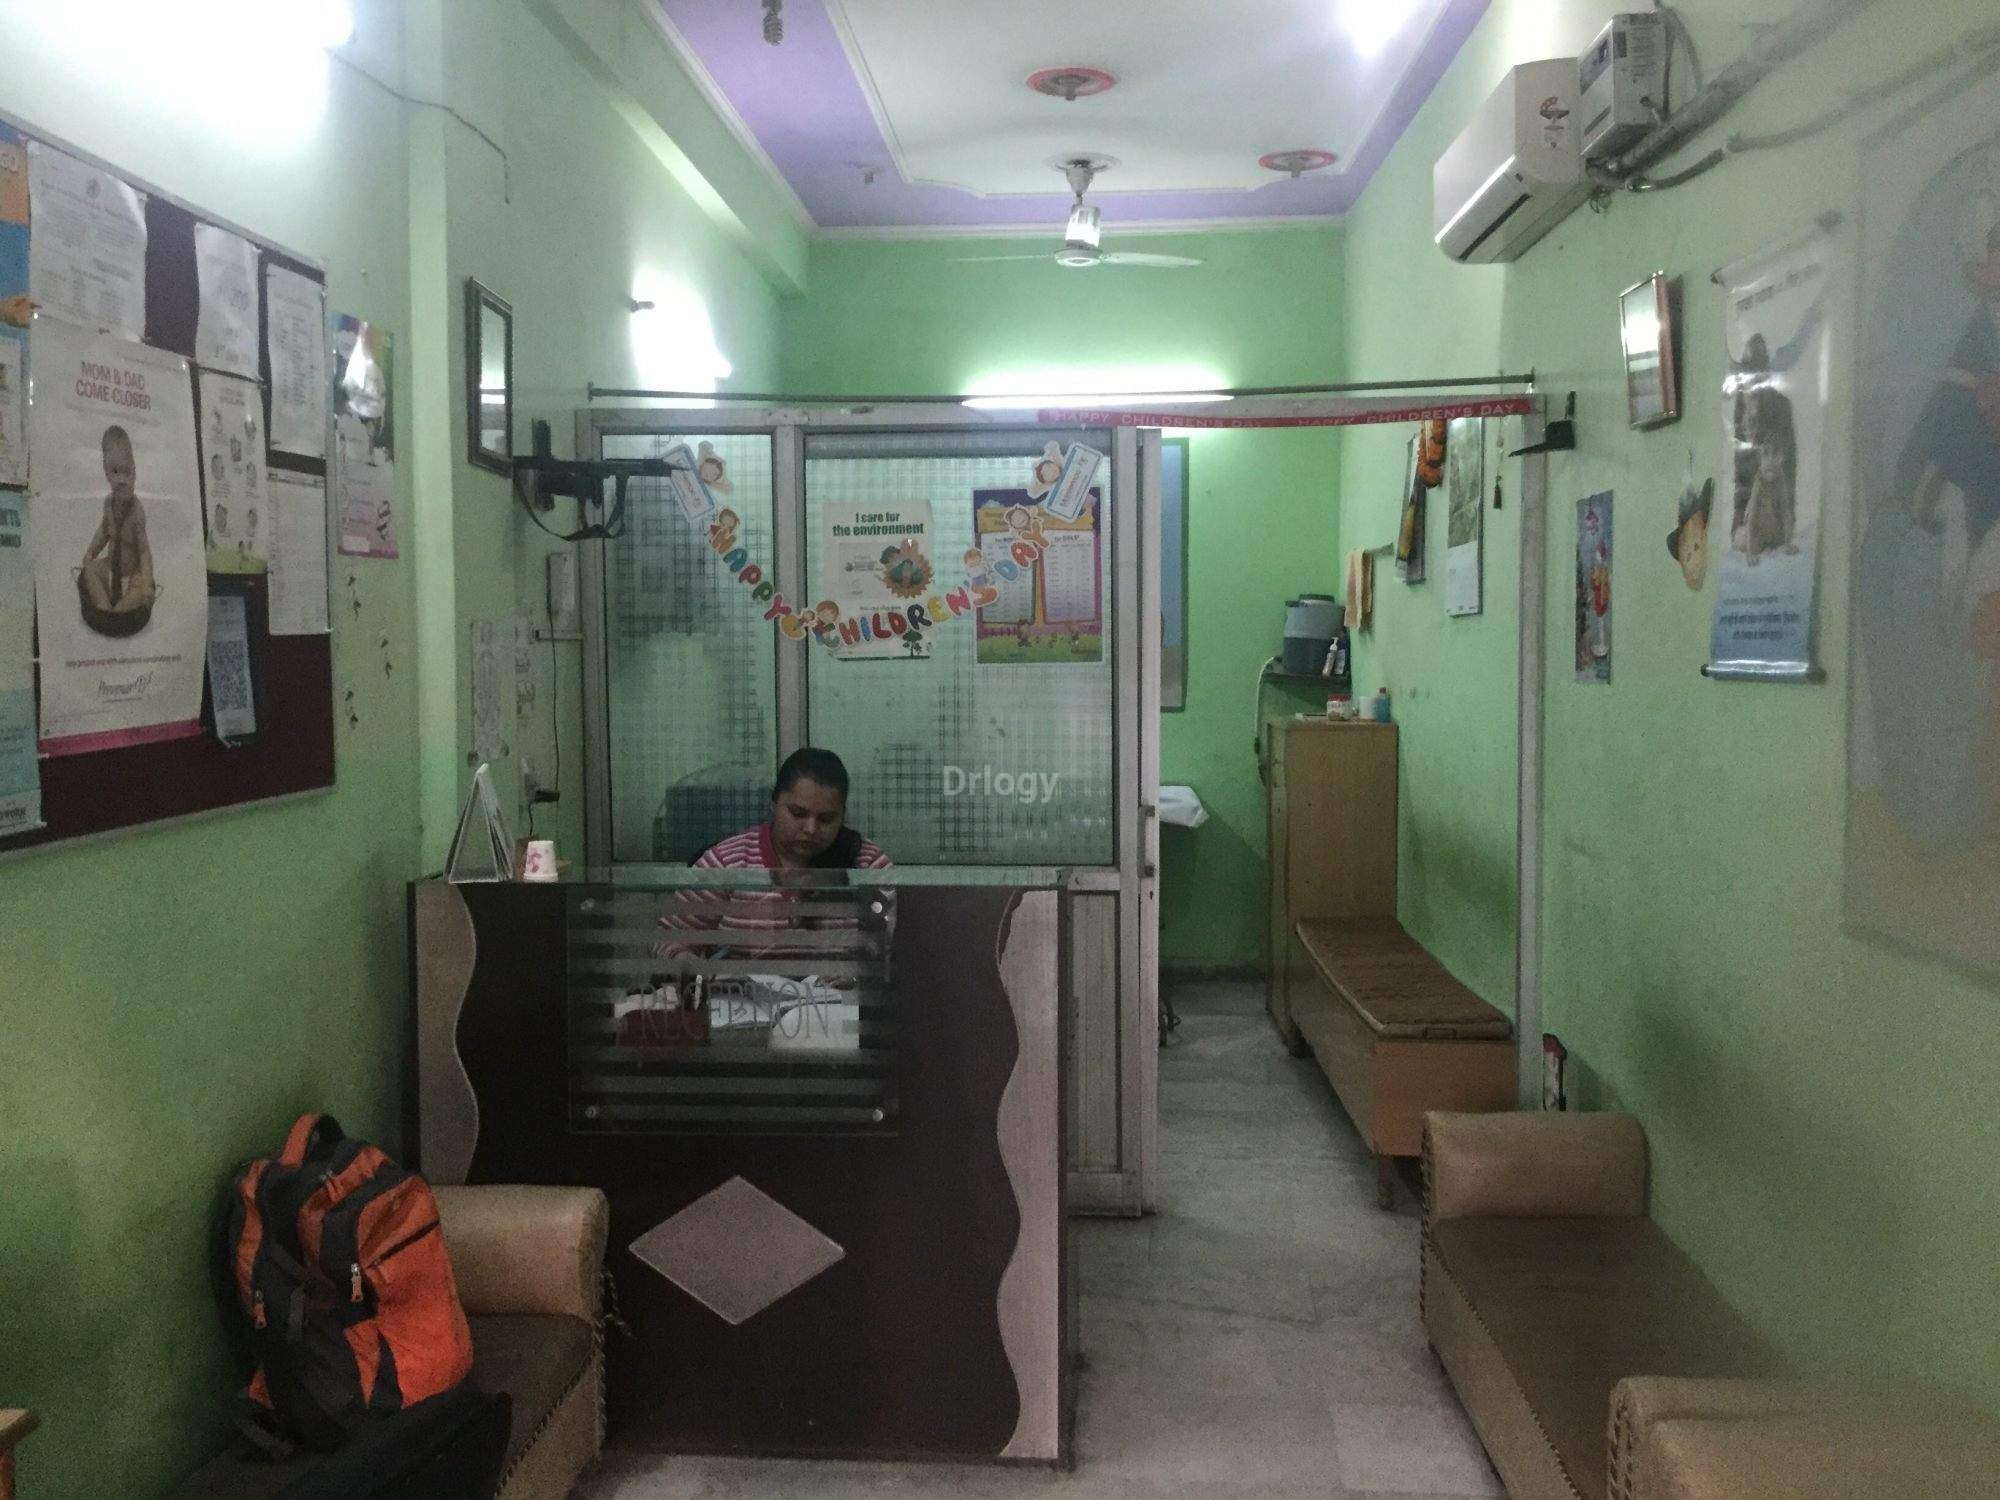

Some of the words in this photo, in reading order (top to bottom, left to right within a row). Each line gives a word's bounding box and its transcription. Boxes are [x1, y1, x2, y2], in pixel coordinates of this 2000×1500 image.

[76, 380, 110, 402] COME
[112, 388, 151, 411] CLOSER
[1366, 406, 1473, 424] CHILDREN'S
[1480, 402, 1517, 416] DAY
[861, 513, 884, 523] care
[885, 512, 900, 522] for
[832, 525, 851, 537] the
[853, 523, 924, 536] environment
[994, 520, 1051, 583] DAY
